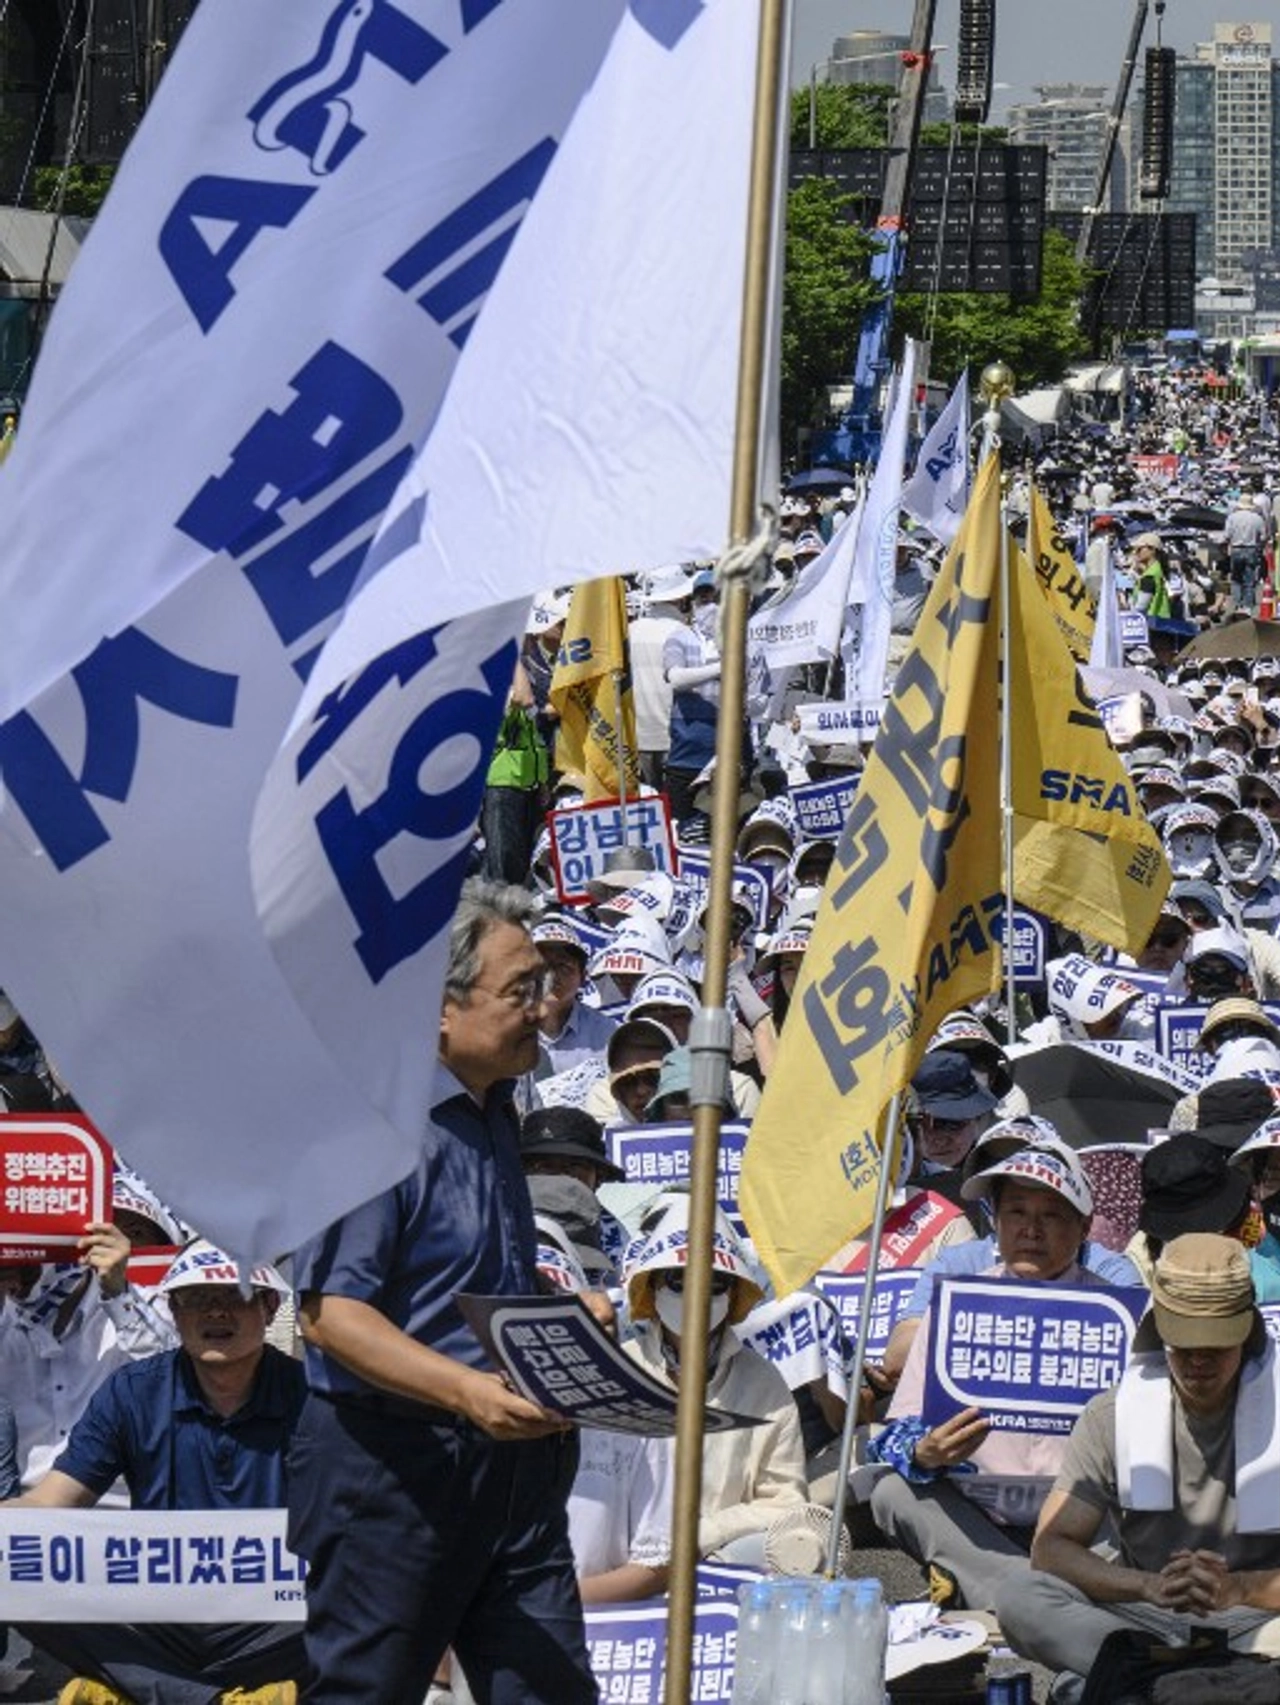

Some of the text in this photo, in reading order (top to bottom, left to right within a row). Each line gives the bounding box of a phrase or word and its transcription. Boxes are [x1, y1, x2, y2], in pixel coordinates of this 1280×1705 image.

[555, 806, 661, 853] 강남구
[4, 1152, 87, 1181] 정책추진
[4, 1187, 88, 1216] 위협한다
[952, 1310, 1123, 1355] 의료농단 교육농단
[951, 1347, 1121, 1389] 필수의료 붕괴된다
[0, 1535, 311, 1584] 들이 살리겠습니
[585, 1637, 656, 1671] 료농단
